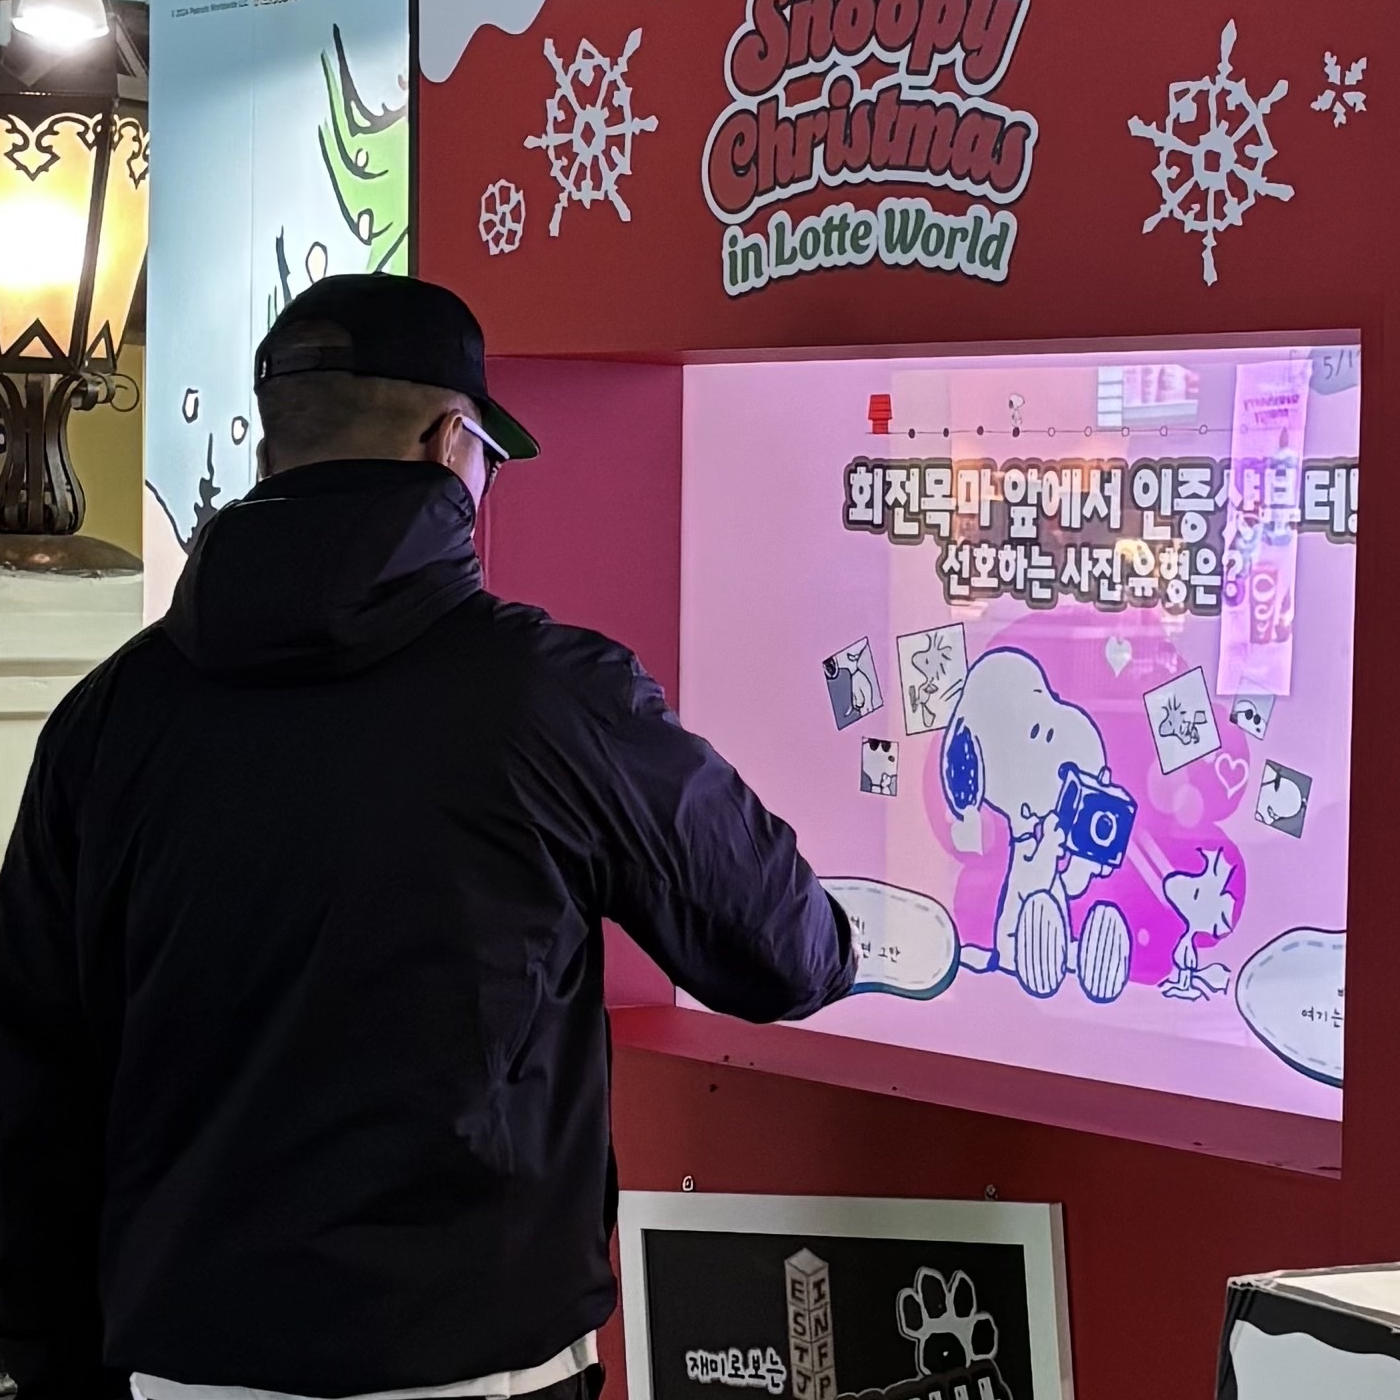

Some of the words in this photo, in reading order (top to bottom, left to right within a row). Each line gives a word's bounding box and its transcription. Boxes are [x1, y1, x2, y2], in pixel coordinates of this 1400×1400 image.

[708, 73, 1032, 214] Christmas
[726, 234, 764, 287] in
[772, 212, 874, 268] Lotte
[883, 207, 1011, 271] World
[848, 465, 1003, 537] 회전목마
[1003, 466, 1123, 540] 앞에서
[941, 545, 1056, 599] 선호하는
[1060, 546, 1124, 599] 사진
[1126, 546, 1244, 607] 유형은?
